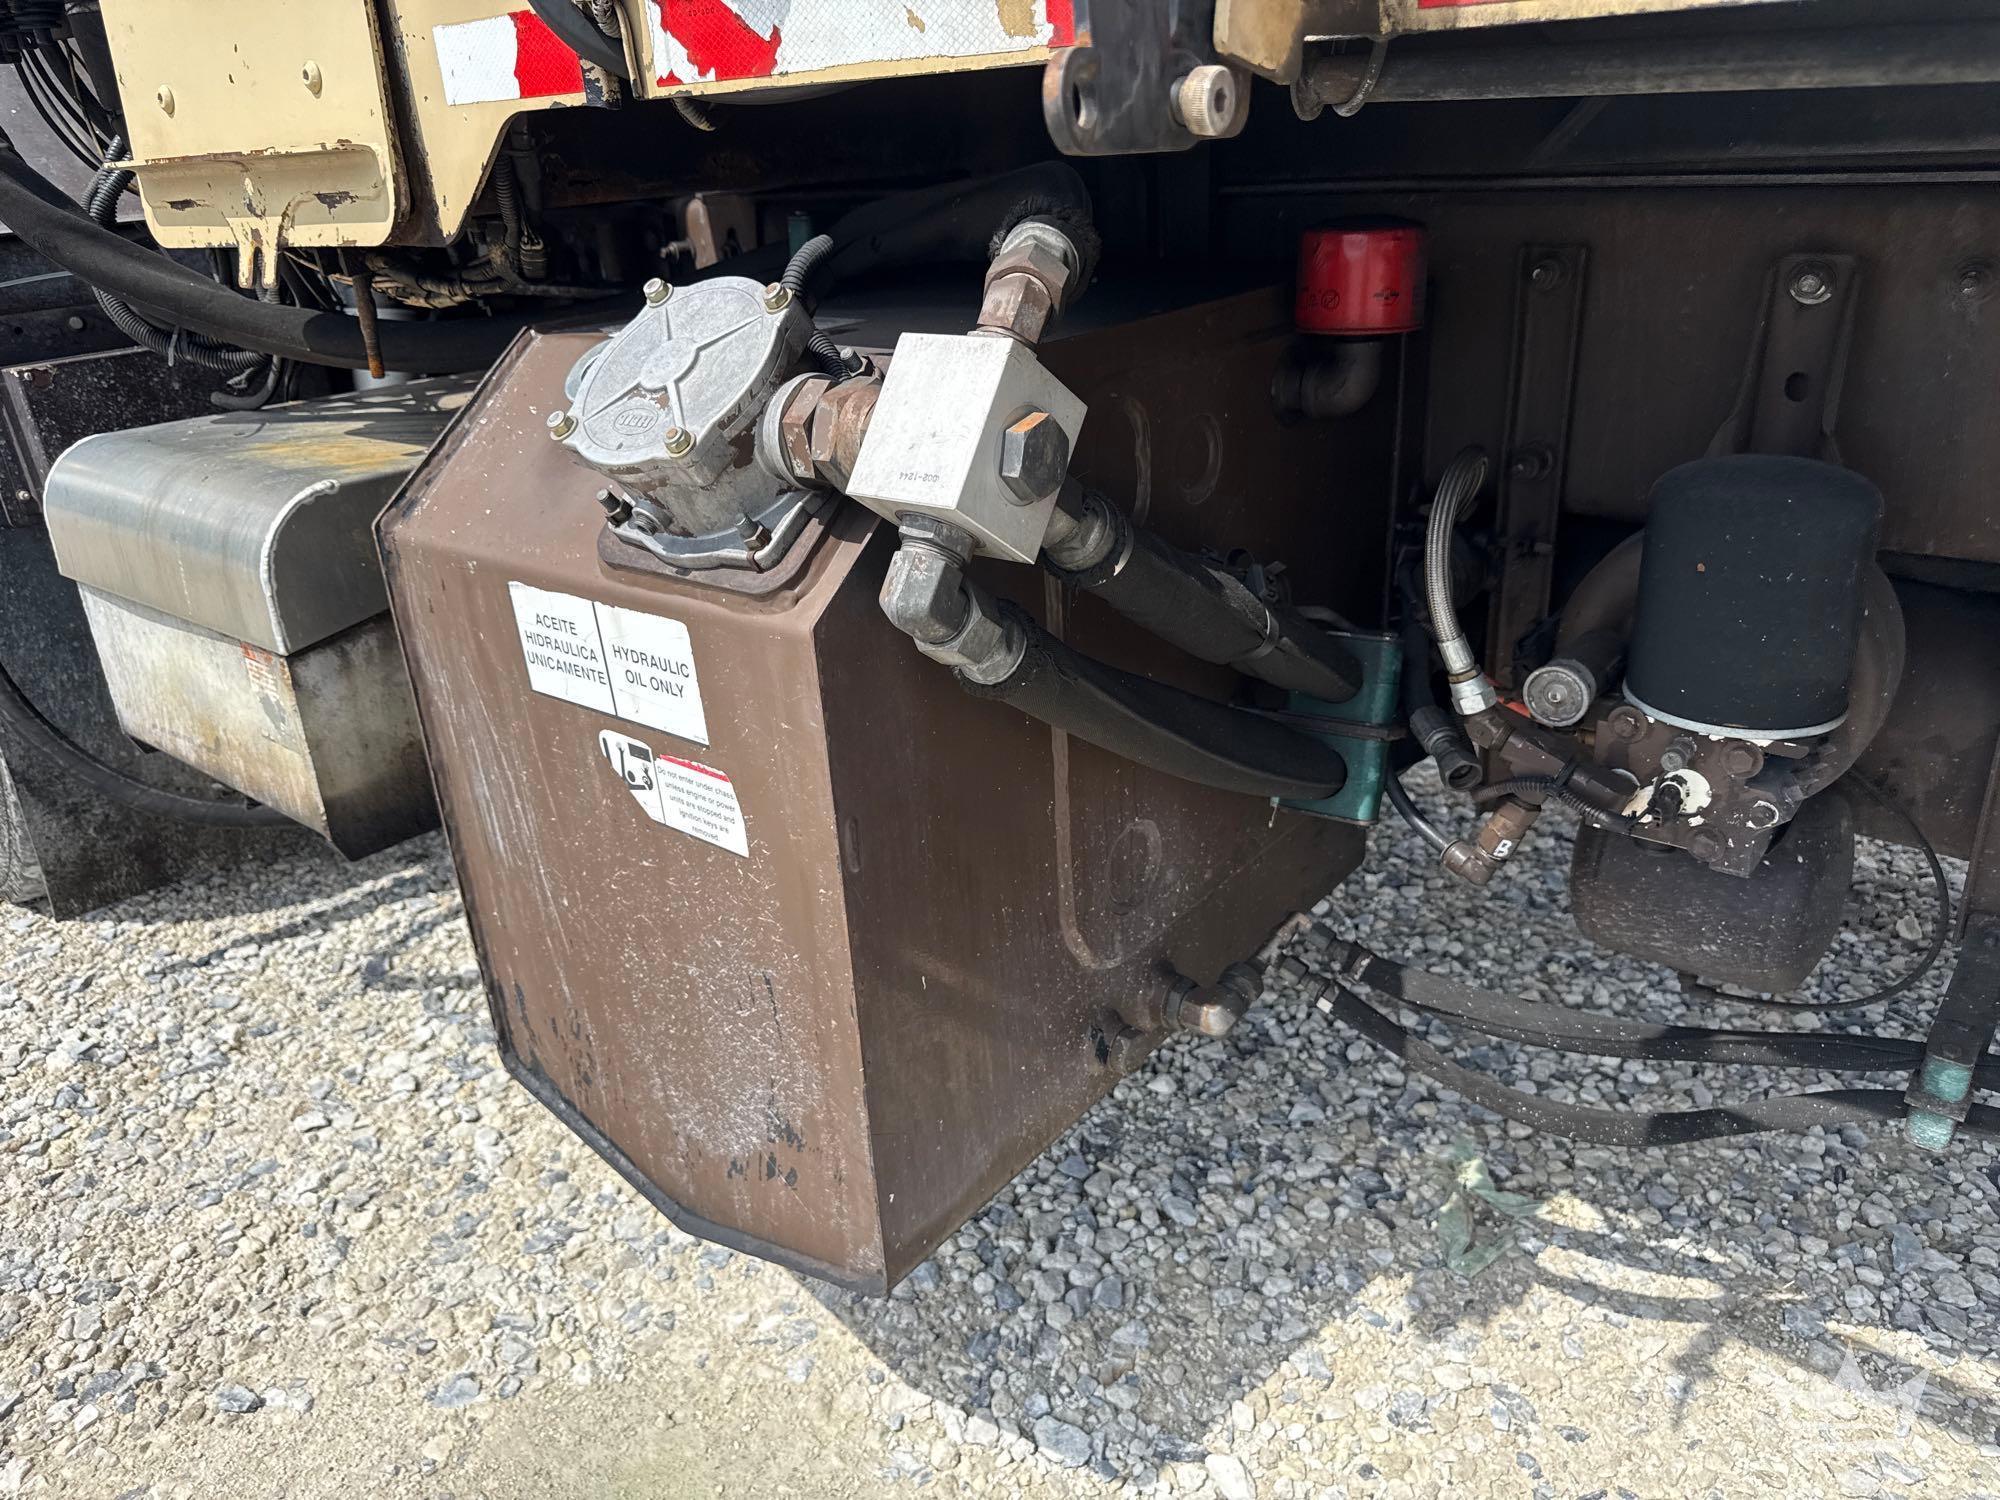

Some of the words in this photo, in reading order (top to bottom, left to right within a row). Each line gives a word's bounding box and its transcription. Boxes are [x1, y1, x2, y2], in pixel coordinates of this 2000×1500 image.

[536, 612, 578, 636] ACEITE
[524, 630, 599, 663] HIDRAULICA
[612, 644, 690, 678] HYDRAULIC
[526, 650, 607, 686] UNICAMENTE
[625, 669, 648, 688] OIL
[650, 677, 684, 699] ONLY
[657, 765, 667, 775] Do
[667, 771, 678, 780] not
[678, 775, 694, 785] enter
[695, 780, 713, 792] under
[664, 781, 686, 794] unless
[686, 789, 707, 802] engine
[716, 801, 735, 813] power
[669, 794, 685, 806] units
[686, 800, 696, 810] are
[697, 804, 722, 820] stopped
[723, 814, 736, 825] and
[703, 817, 718, 830] keys
[719, 825, 729, 834] are
[1493, 839, 1512, 857] B
